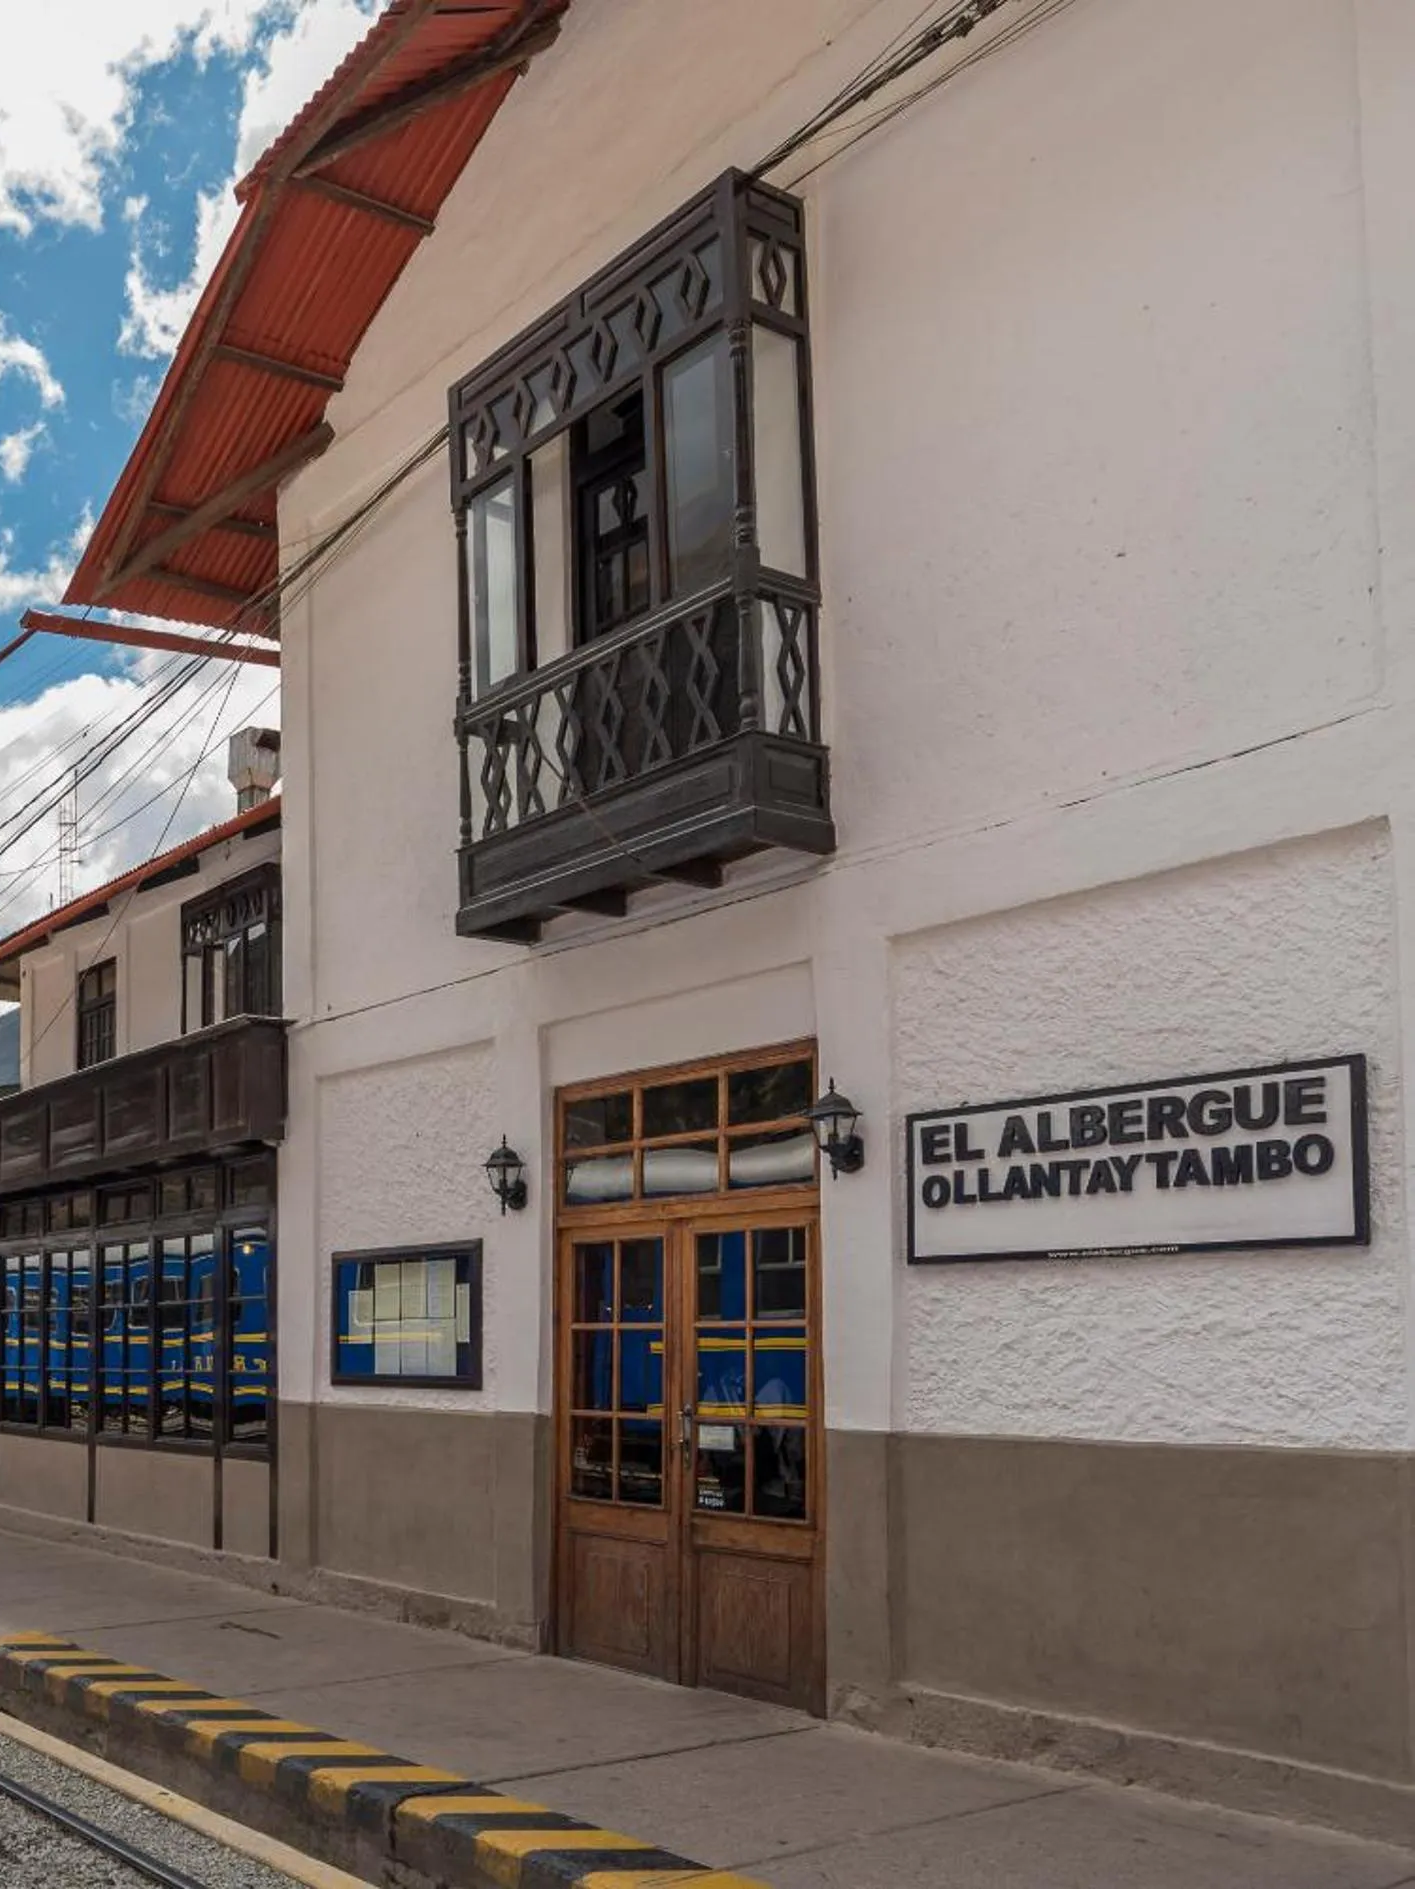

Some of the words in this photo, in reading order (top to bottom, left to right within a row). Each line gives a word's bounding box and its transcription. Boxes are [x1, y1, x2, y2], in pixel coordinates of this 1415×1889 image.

[920, 1122, 985, 1166] EL
[997, 1076, 1328, 1159] ALBERGUE
[921, 1133, 1336, 1210] OLLANTAYTAMBO
